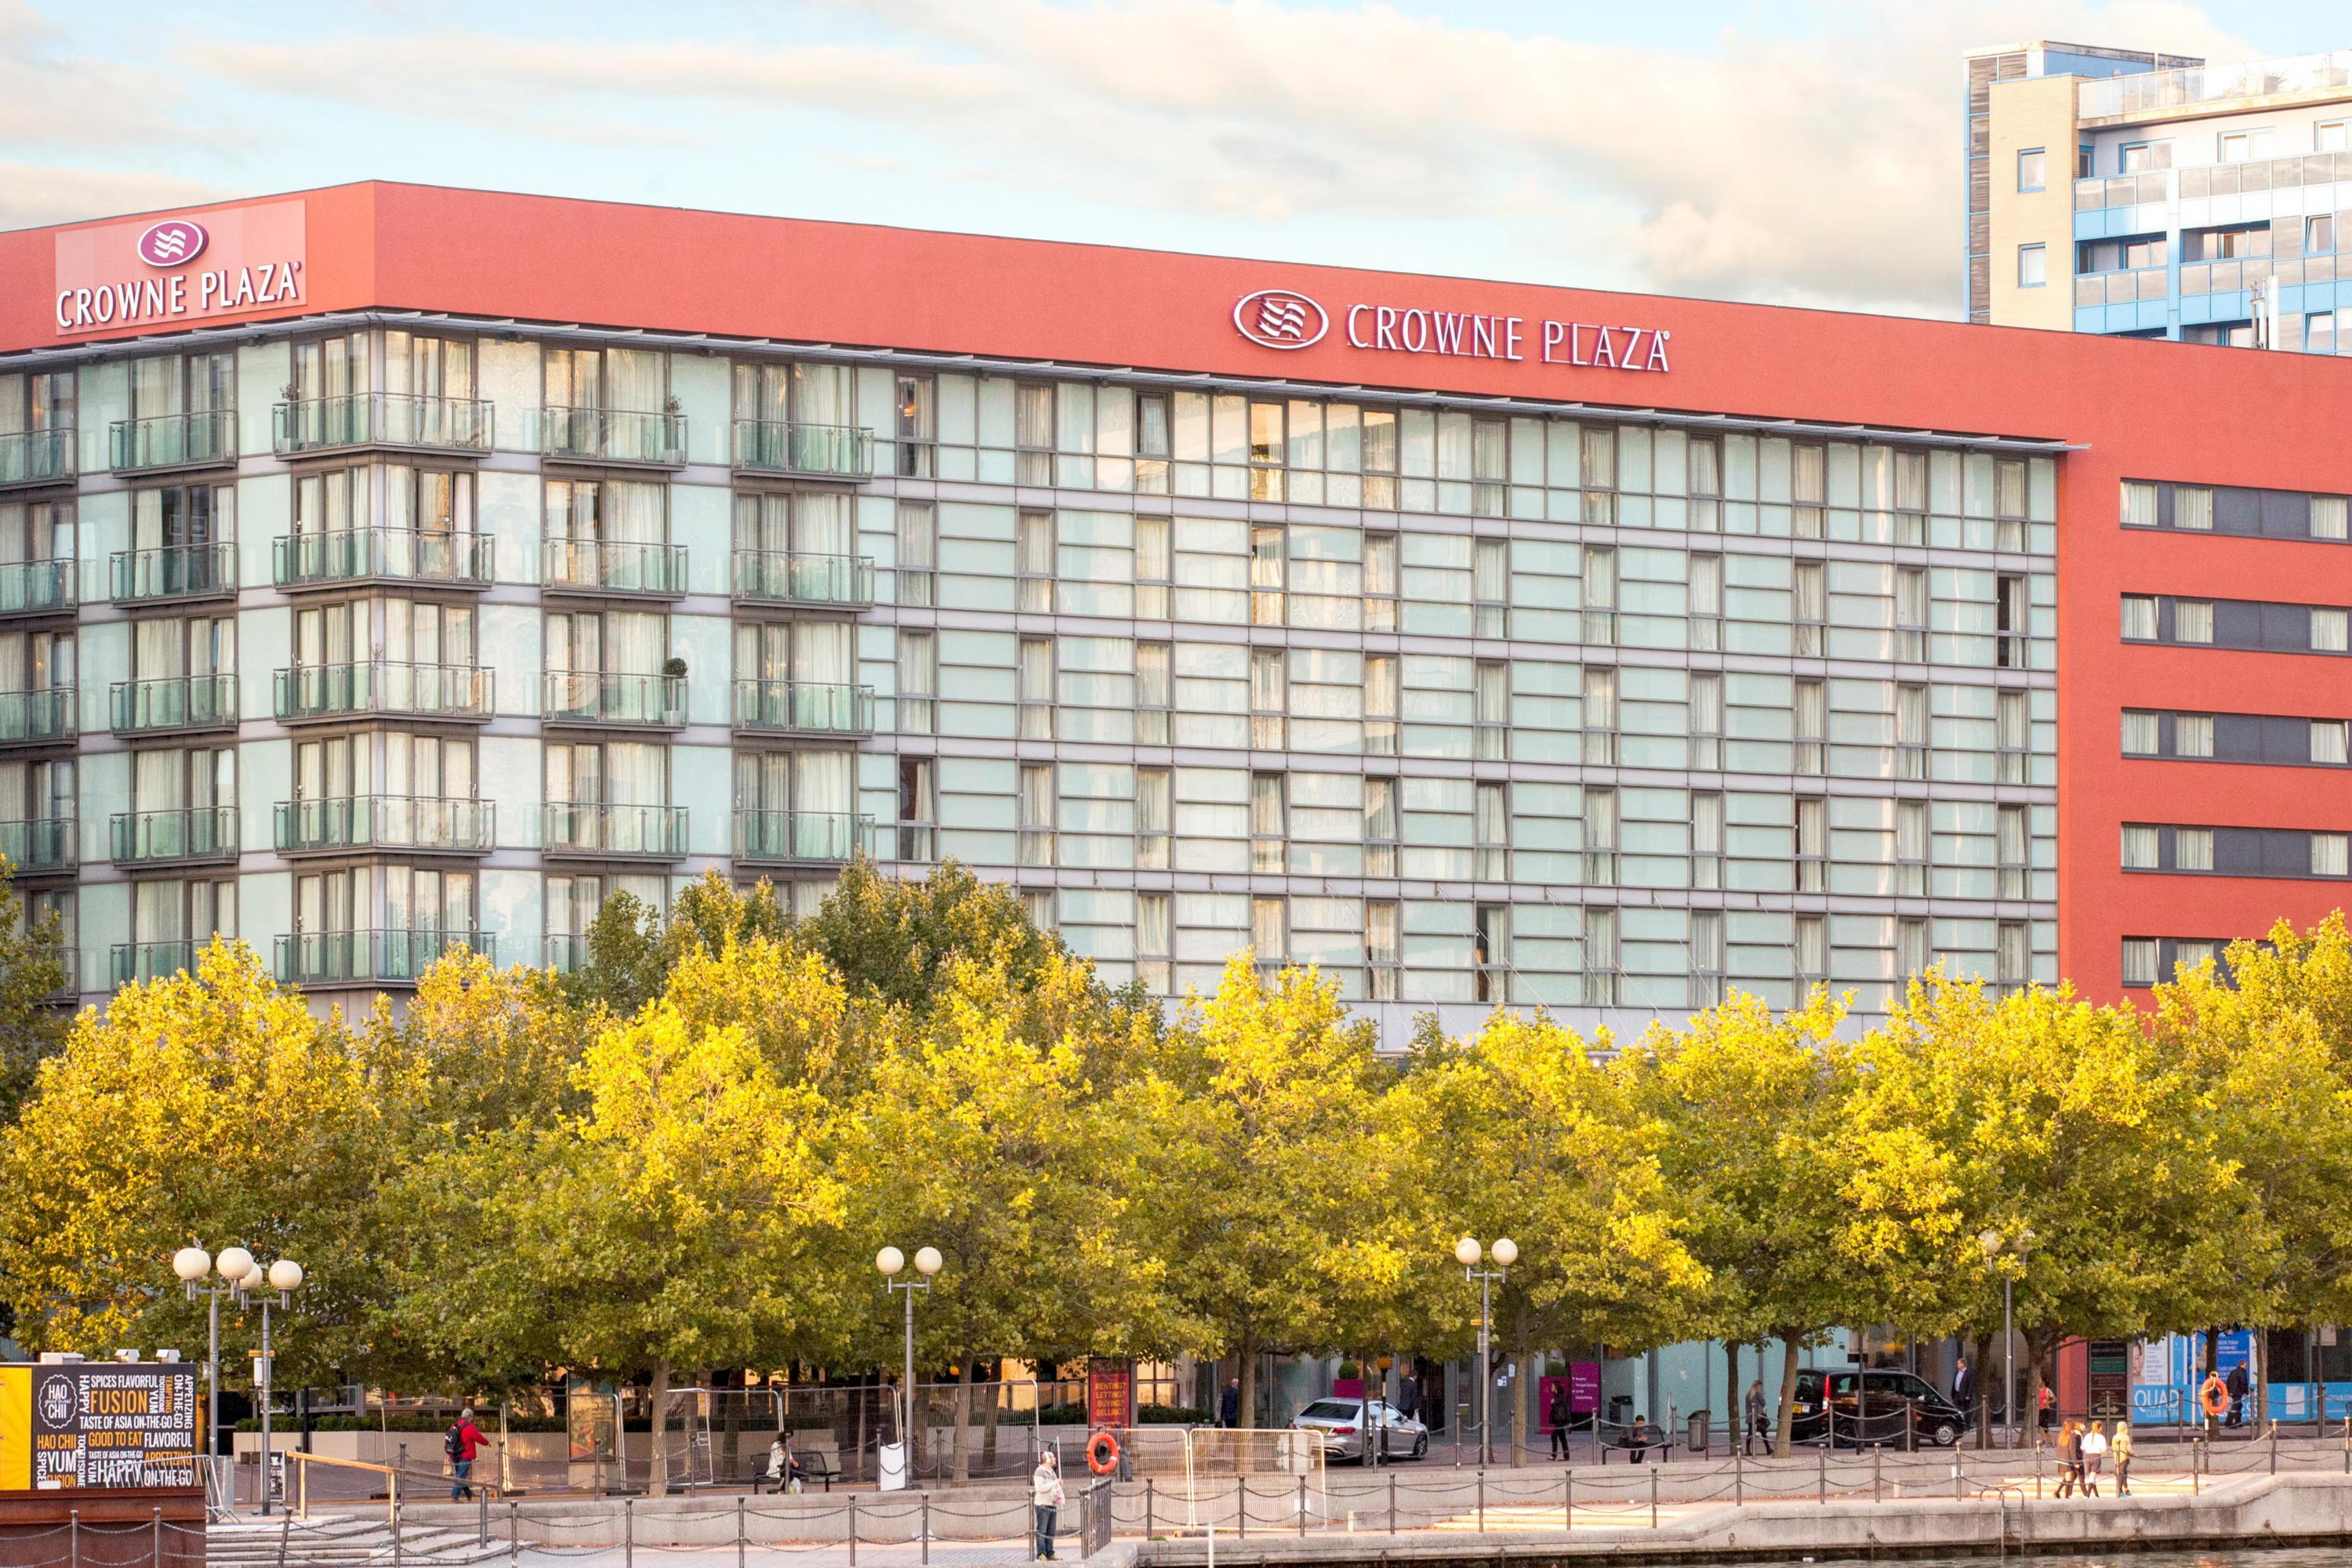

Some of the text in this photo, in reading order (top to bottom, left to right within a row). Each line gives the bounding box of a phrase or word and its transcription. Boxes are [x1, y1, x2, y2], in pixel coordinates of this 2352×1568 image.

[56, 275, 187, 328] CROWNE
[1346, 303, 1524, 361] CROWNE
[91, 1374, 158, 1388] SPICES FLAVORFUL
[1095, 1382, 1127, 1391] RENTING?
[49, 1385, 67, 1399] HAO
[79, 1374, 89, 1414] HAPPY
[1095, 1391, 1126, 1399] LETTING?
[2134, 1388, 2179, 1412] QUAD
[90, 1390, 147, 1414] FUSION
[149, 1390, 158, 1414] YUM
[173, 1374, 184, 1428] ON-THE-GO
[184, 1374, 194, 1429] APPETIZING
[48, 1404, 67, 1419] CHII
[1096, 1408, 1127, 1417] SELLING?
[79, 1416, 172, 1429] TASTE OF ASIA ON-THE-GO
[37, 1433, 77, 1450] HAO CHII
[88, 1432, 143, 1447] GOOD TO EAT
[144, 1432, 193, 1448] FLAVORFUL
[47, 1450, 77, 1472] YUM
[120, 1450, 143, 1459] ON-THE-GO
[144, 1451, 193, 1466] APPETIZING
[88, 1461, 97, 1483] YUM
[97, 1460, 143, 1483] HAPPY
[144, 1469, 193, 1486] ON-THE-GO
